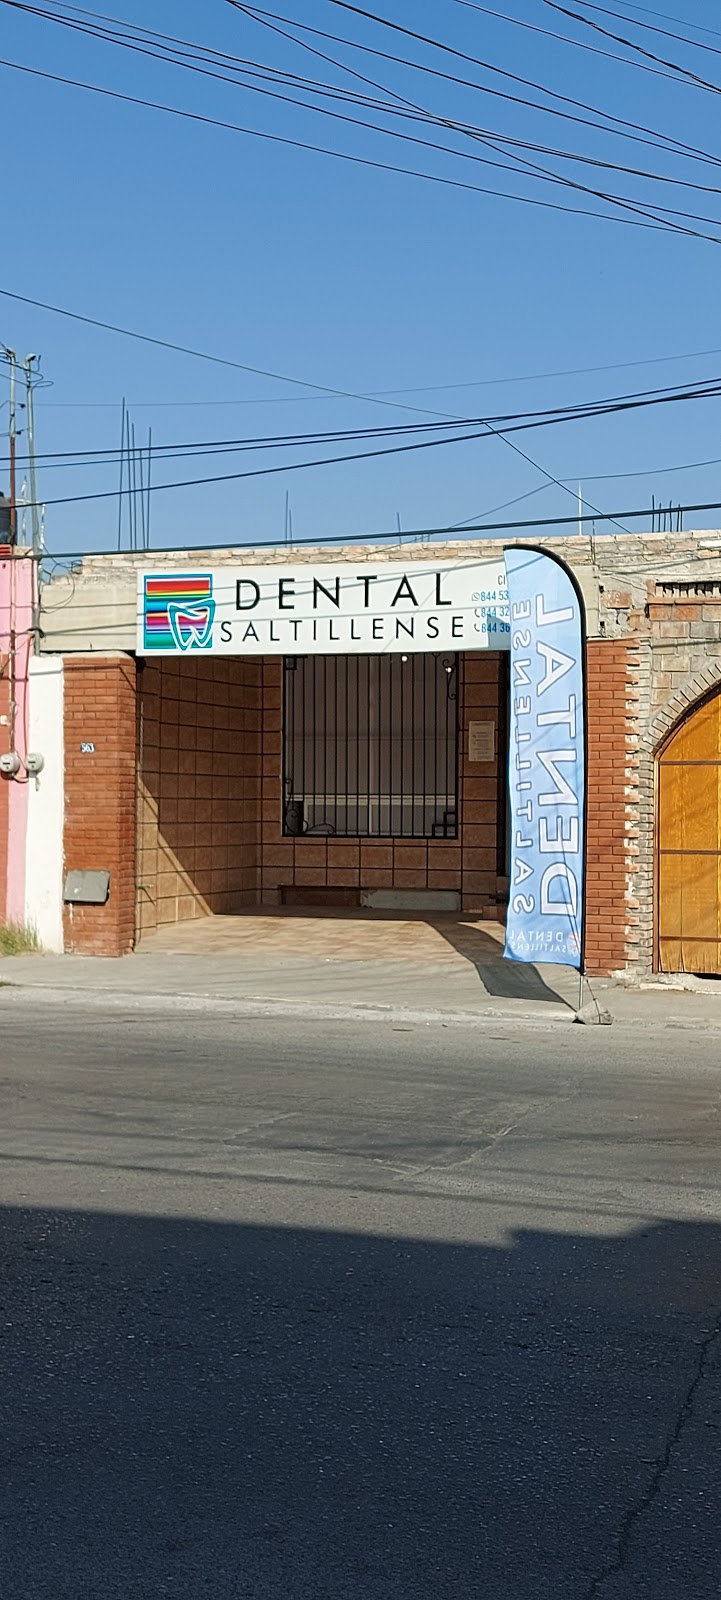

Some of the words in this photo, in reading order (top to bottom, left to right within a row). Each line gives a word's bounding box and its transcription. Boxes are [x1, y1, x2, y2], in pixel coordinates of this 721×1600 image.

[235, 572, 452, 611] DENTAL
[480, 591, 496, 602] 844
[481, 607, 497, 618] 844
[220, 615, 464, 643] SALTILLENSE
[481, 622, 497, 633] 844
